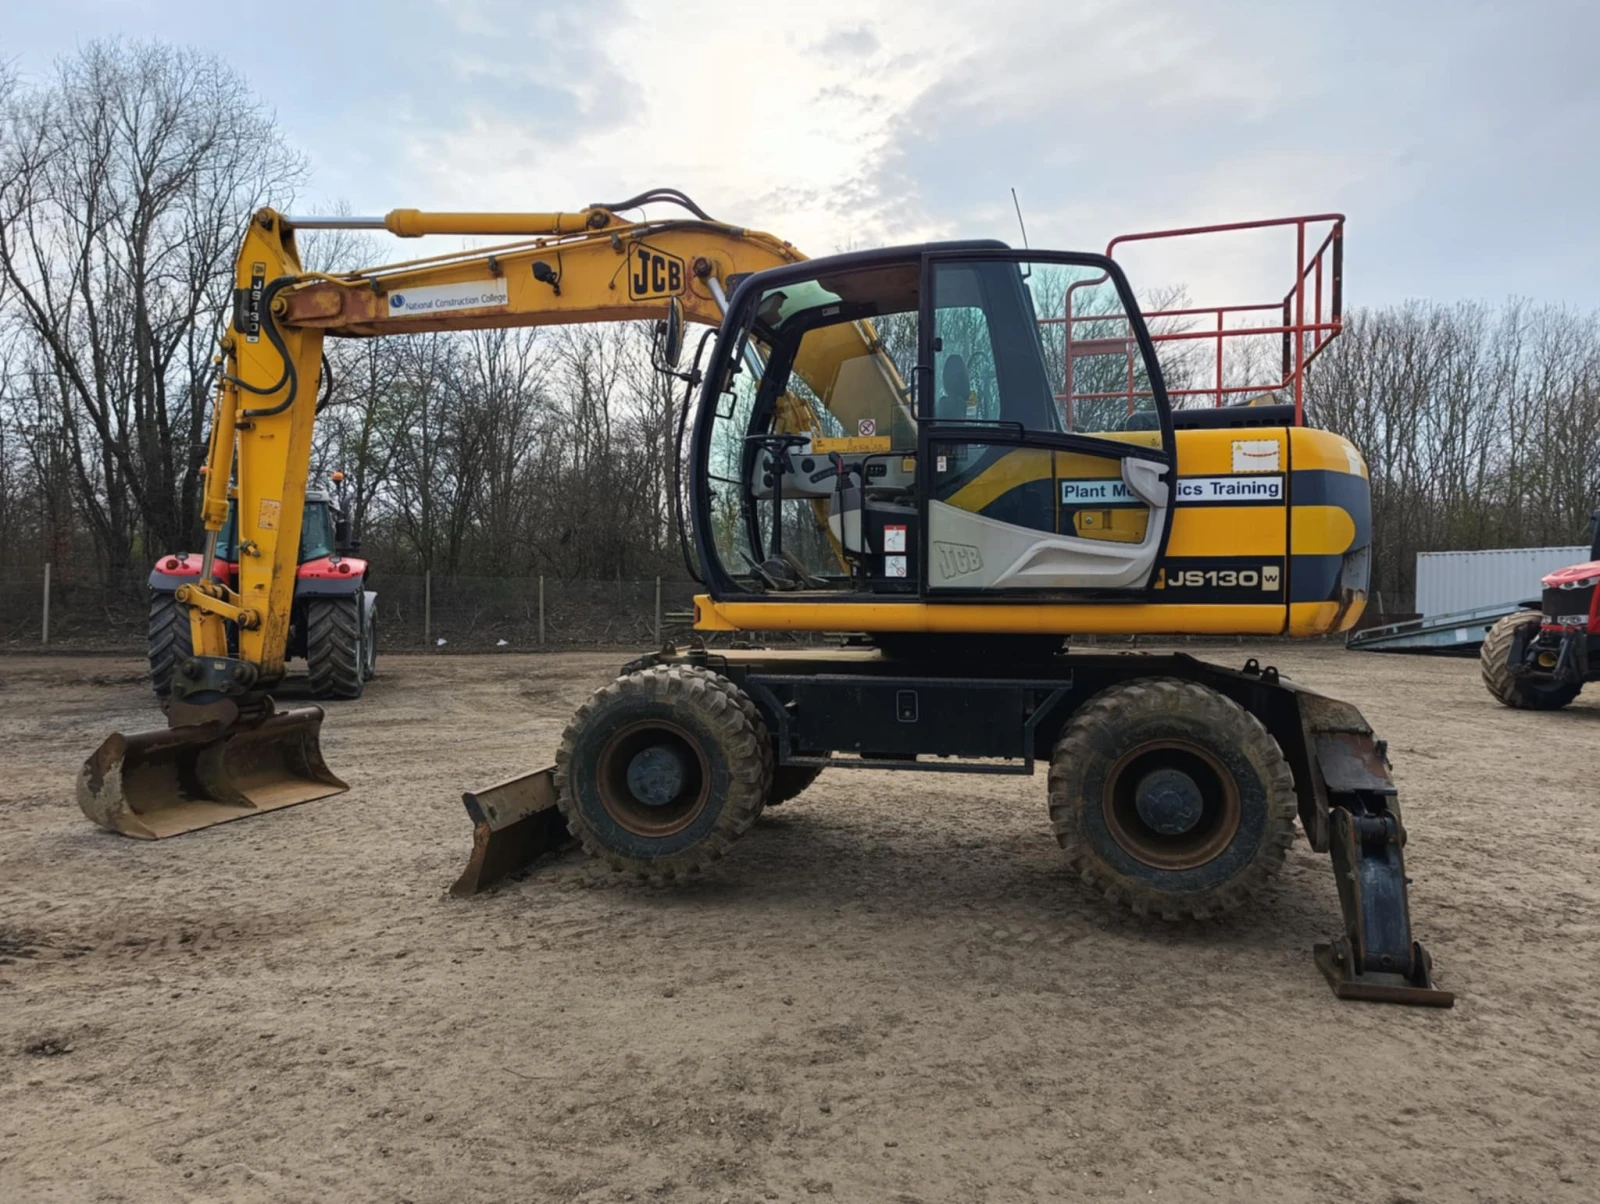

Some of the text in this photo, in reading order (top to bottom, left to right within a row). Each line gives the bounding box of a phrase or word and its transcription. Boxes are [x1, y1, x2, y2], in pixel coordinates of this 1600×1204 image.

[633, 248, 681, 295] JCB
[249, 280, 262, 332] JS130
[405, 293, 507, 311] National Construction College
[1064, 484, 1106, 498] Plant
[1210, 481, 1280, 497] Training
[937, 545, 981, 579] JCB
[1167, 570, 1259, 587] JS130
